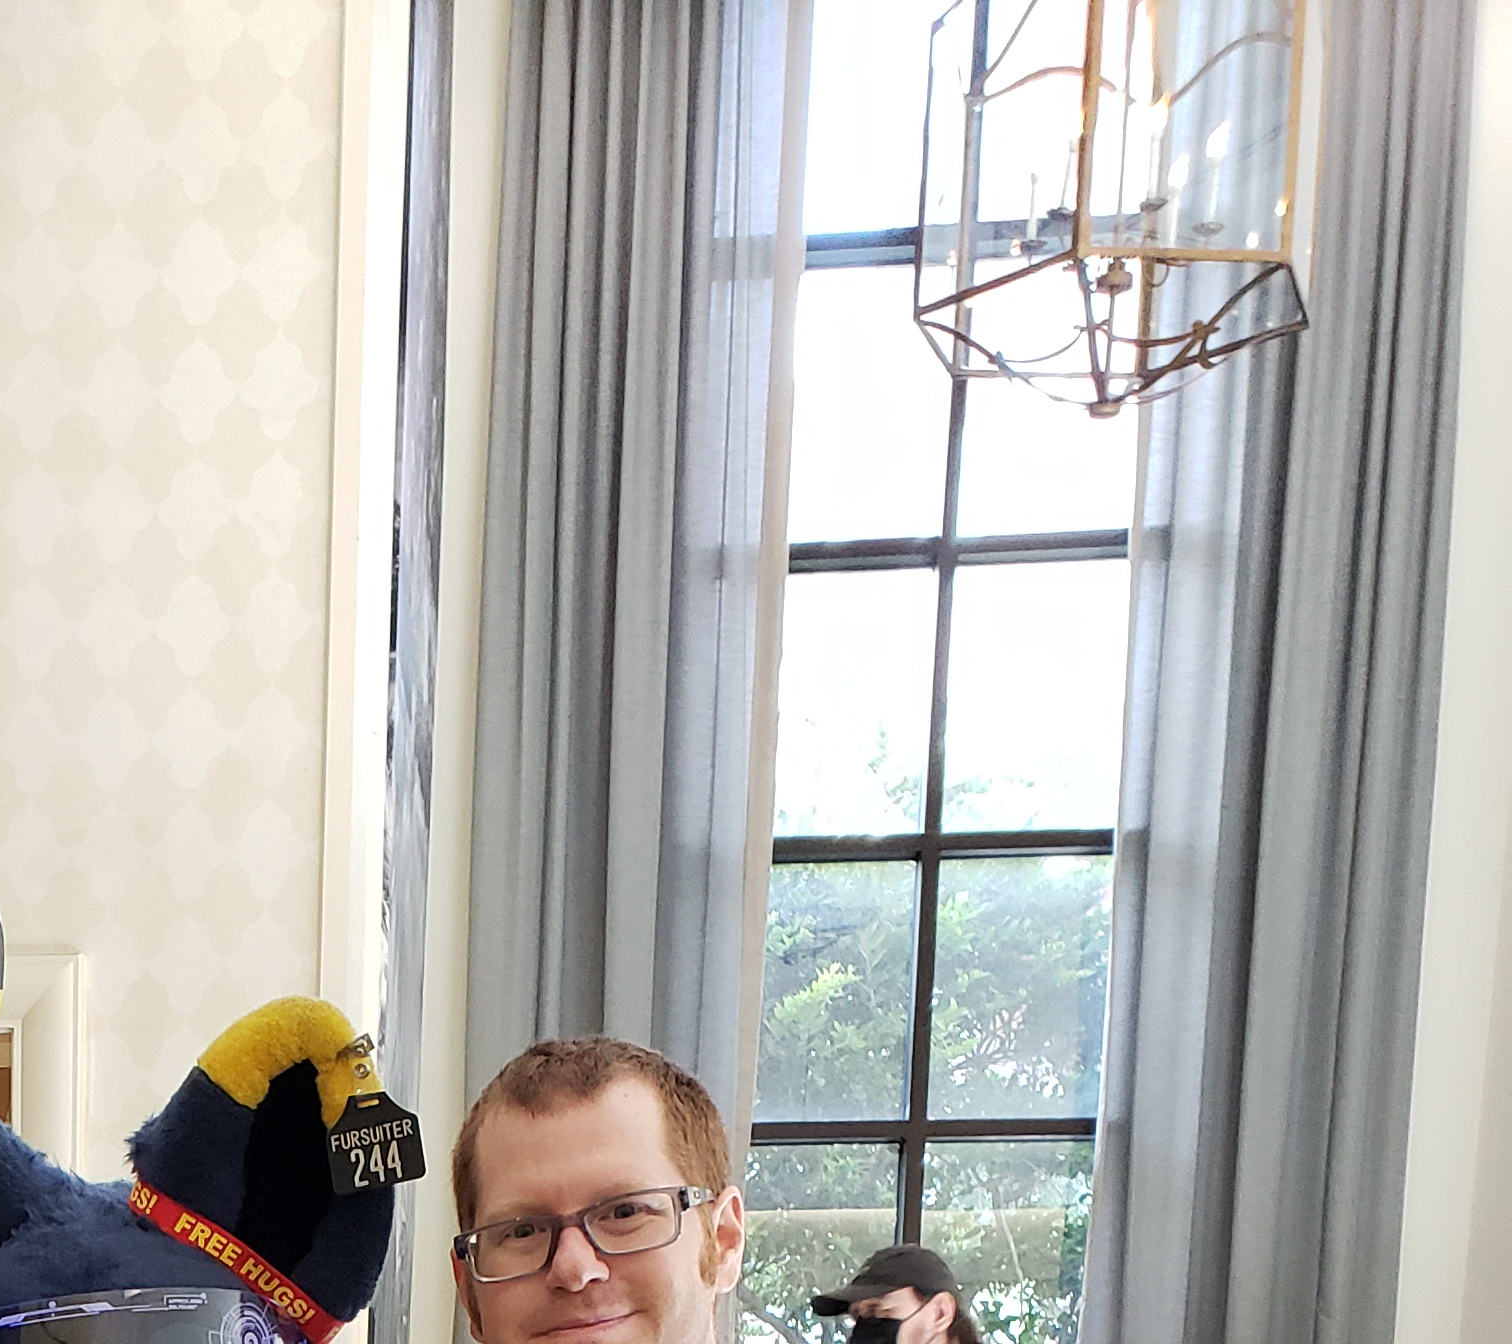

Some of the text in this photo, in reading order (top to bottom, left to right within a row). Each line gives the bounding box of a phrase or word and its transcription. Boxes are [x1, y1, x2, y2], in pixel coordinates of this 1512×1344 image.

[330, 1117, 414, 1153] FURSUITER
[349, 1140, 403, 1189] 244
[130, 1181, 159, 1215] GS!
[174, 1212, 316, 1324] FREE HUGS!
